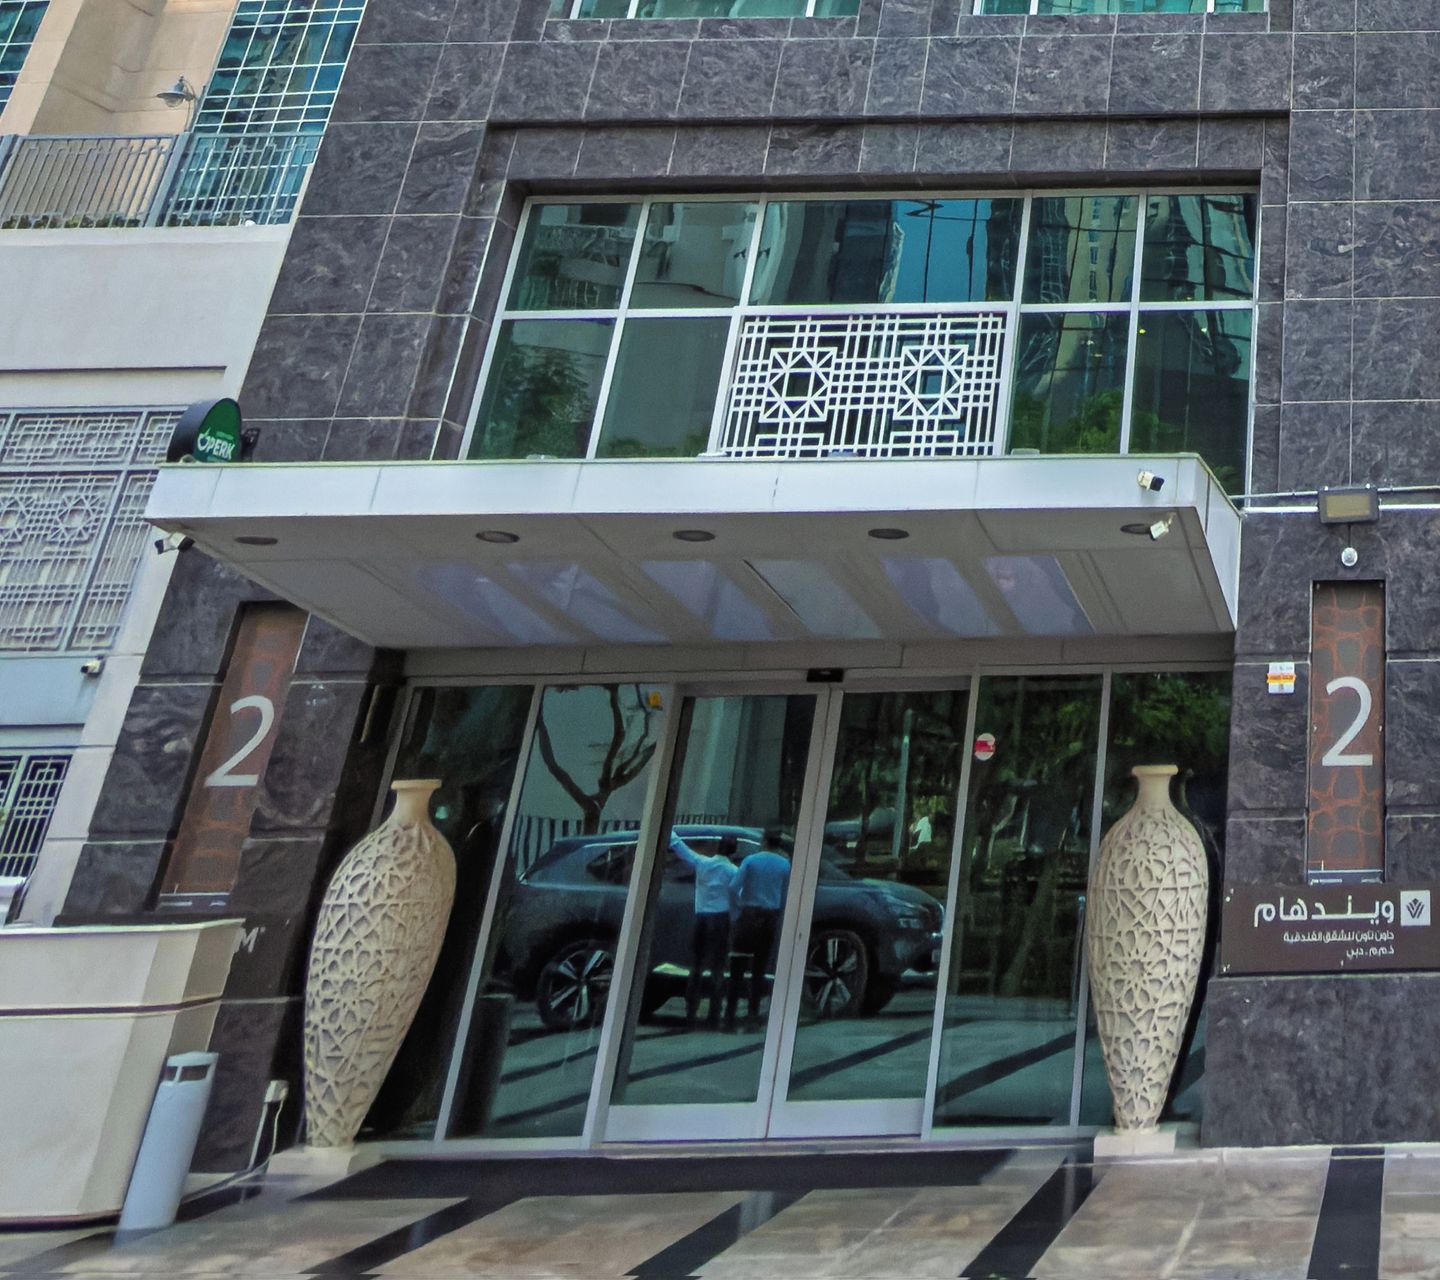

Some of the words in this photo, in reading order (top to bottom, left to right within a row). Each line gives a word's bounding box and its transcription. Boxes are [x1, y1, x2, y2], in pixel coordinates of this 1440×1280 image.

[204, 695, 275, 787] 2
[1321, 675, 1374, 767] 2
[1253, 895, 1395, 928] ويندهام
